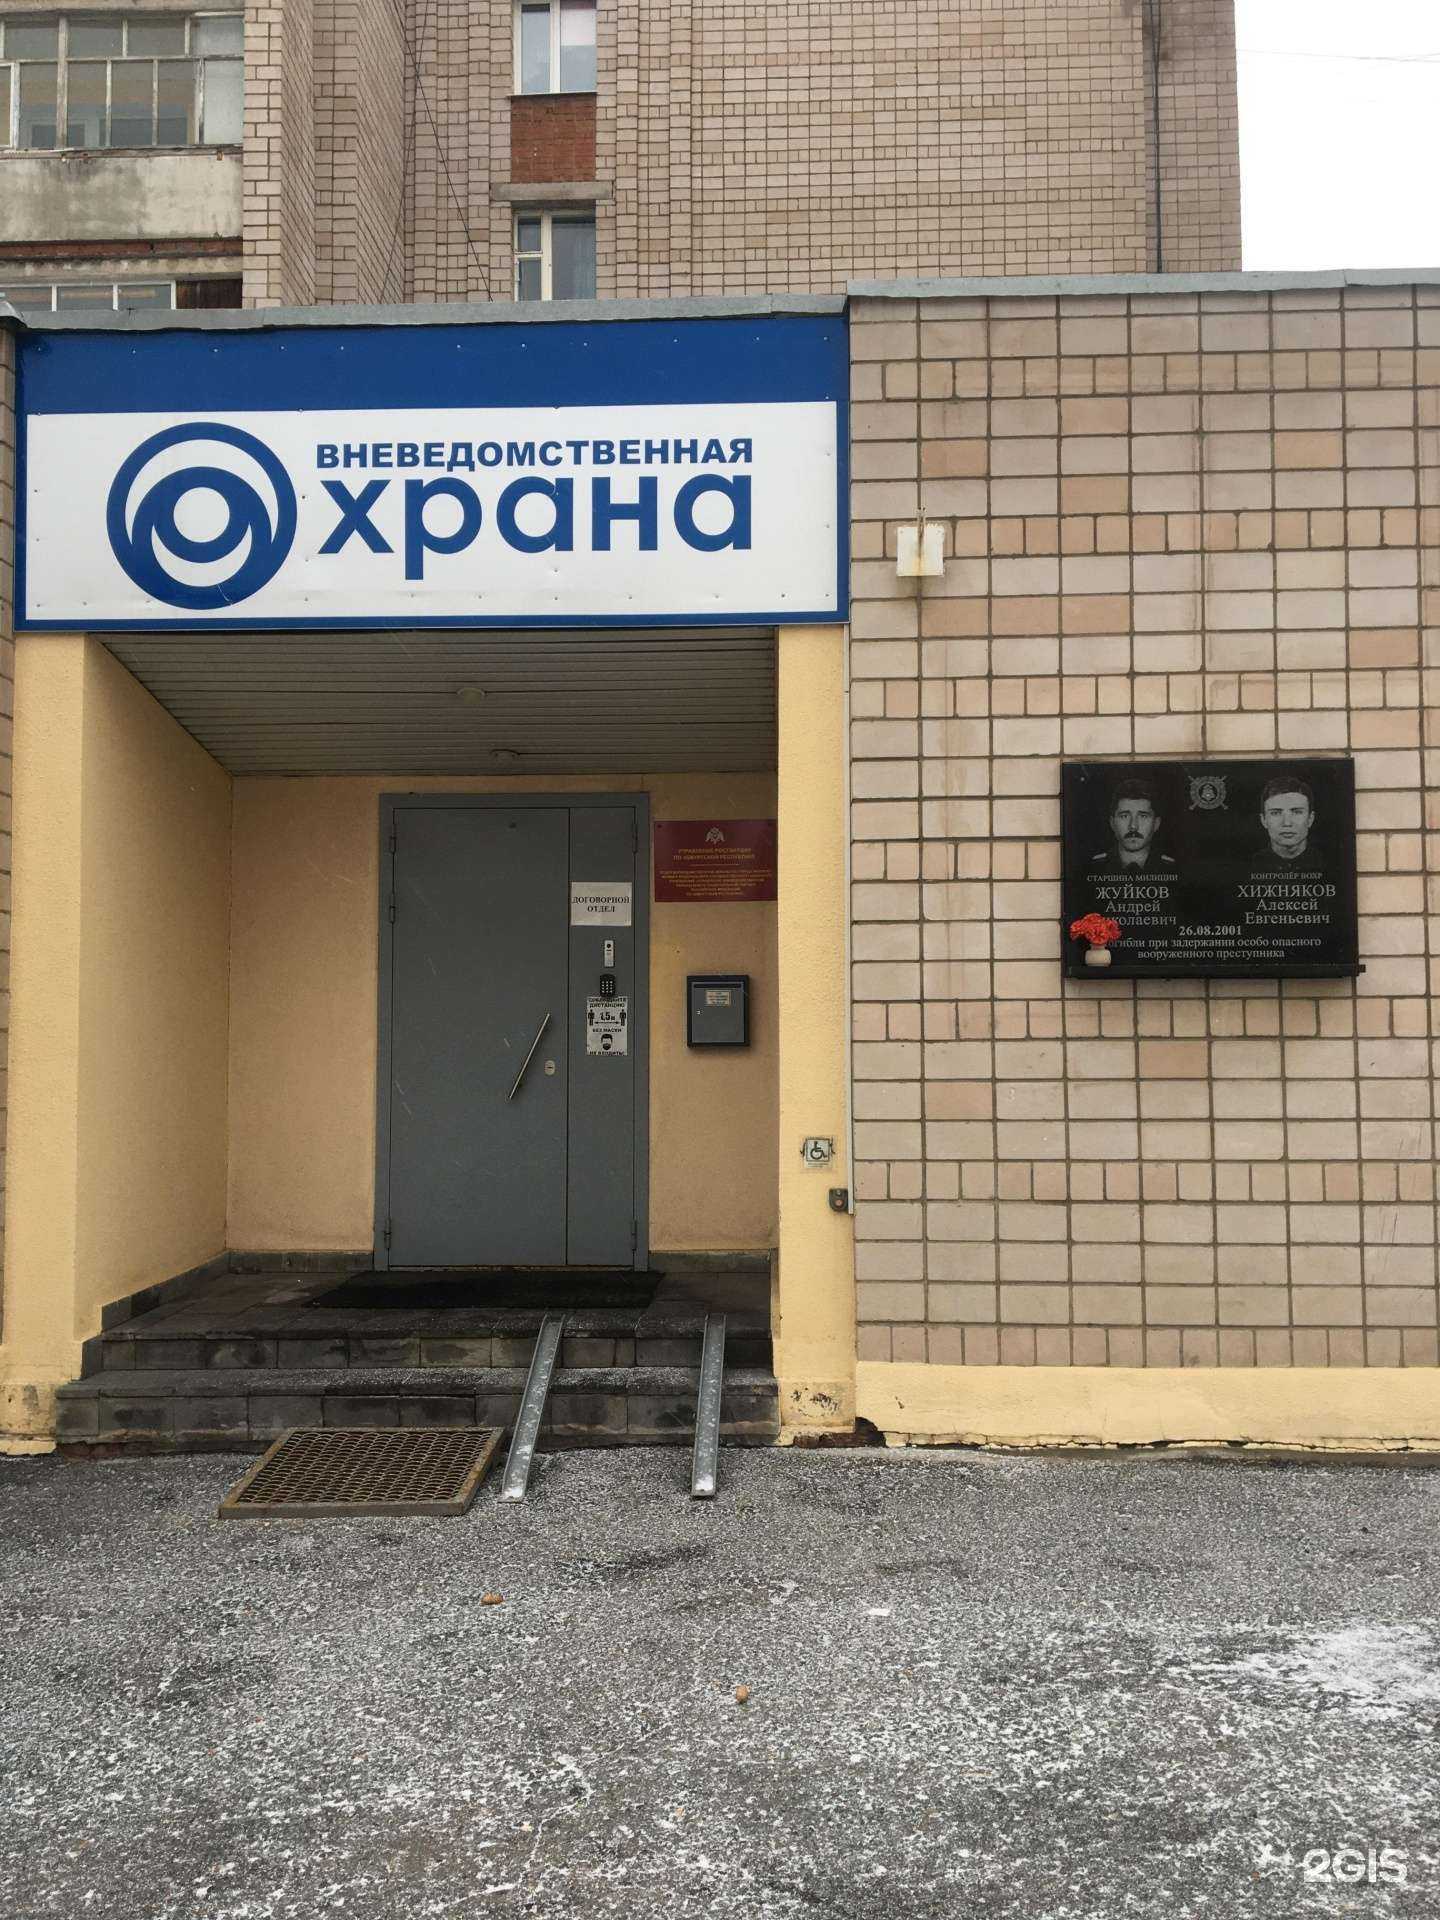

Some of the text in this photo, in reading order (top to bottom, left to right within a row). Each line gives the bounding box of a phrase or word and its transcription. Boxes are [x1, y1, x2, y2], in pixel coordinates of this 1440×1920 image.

[316, 438, 753, 472] ВНЕВЕДОМСТВЕННАЯ
[1087, 874, 1178, 882] СТАРШИНА МИЛИЦИИ
[1095, 883, 1170, 899] ЖУЙКОВ
[1237, 884, 1336, 898] ХИЖНЯКОВ
[571, 896, 630, 904] ДОГОВОРНОЙ
[1256, 899, 1318, 911] Алексей
[1106, 900, 1160, 915] Андрей
[1246, 912, 1330, 925] Евгеньевич
[1179, 925, 1242, 936] 26.08.2001
[1148, 939, 1168, 949] при
[1171, 938, 1235, 949] задержании
[1237, 936, 1269, 947] особо
[1272, 938, 1322, 947] опасного
[1137, 949, 1285, 960] вооруженного преступника
